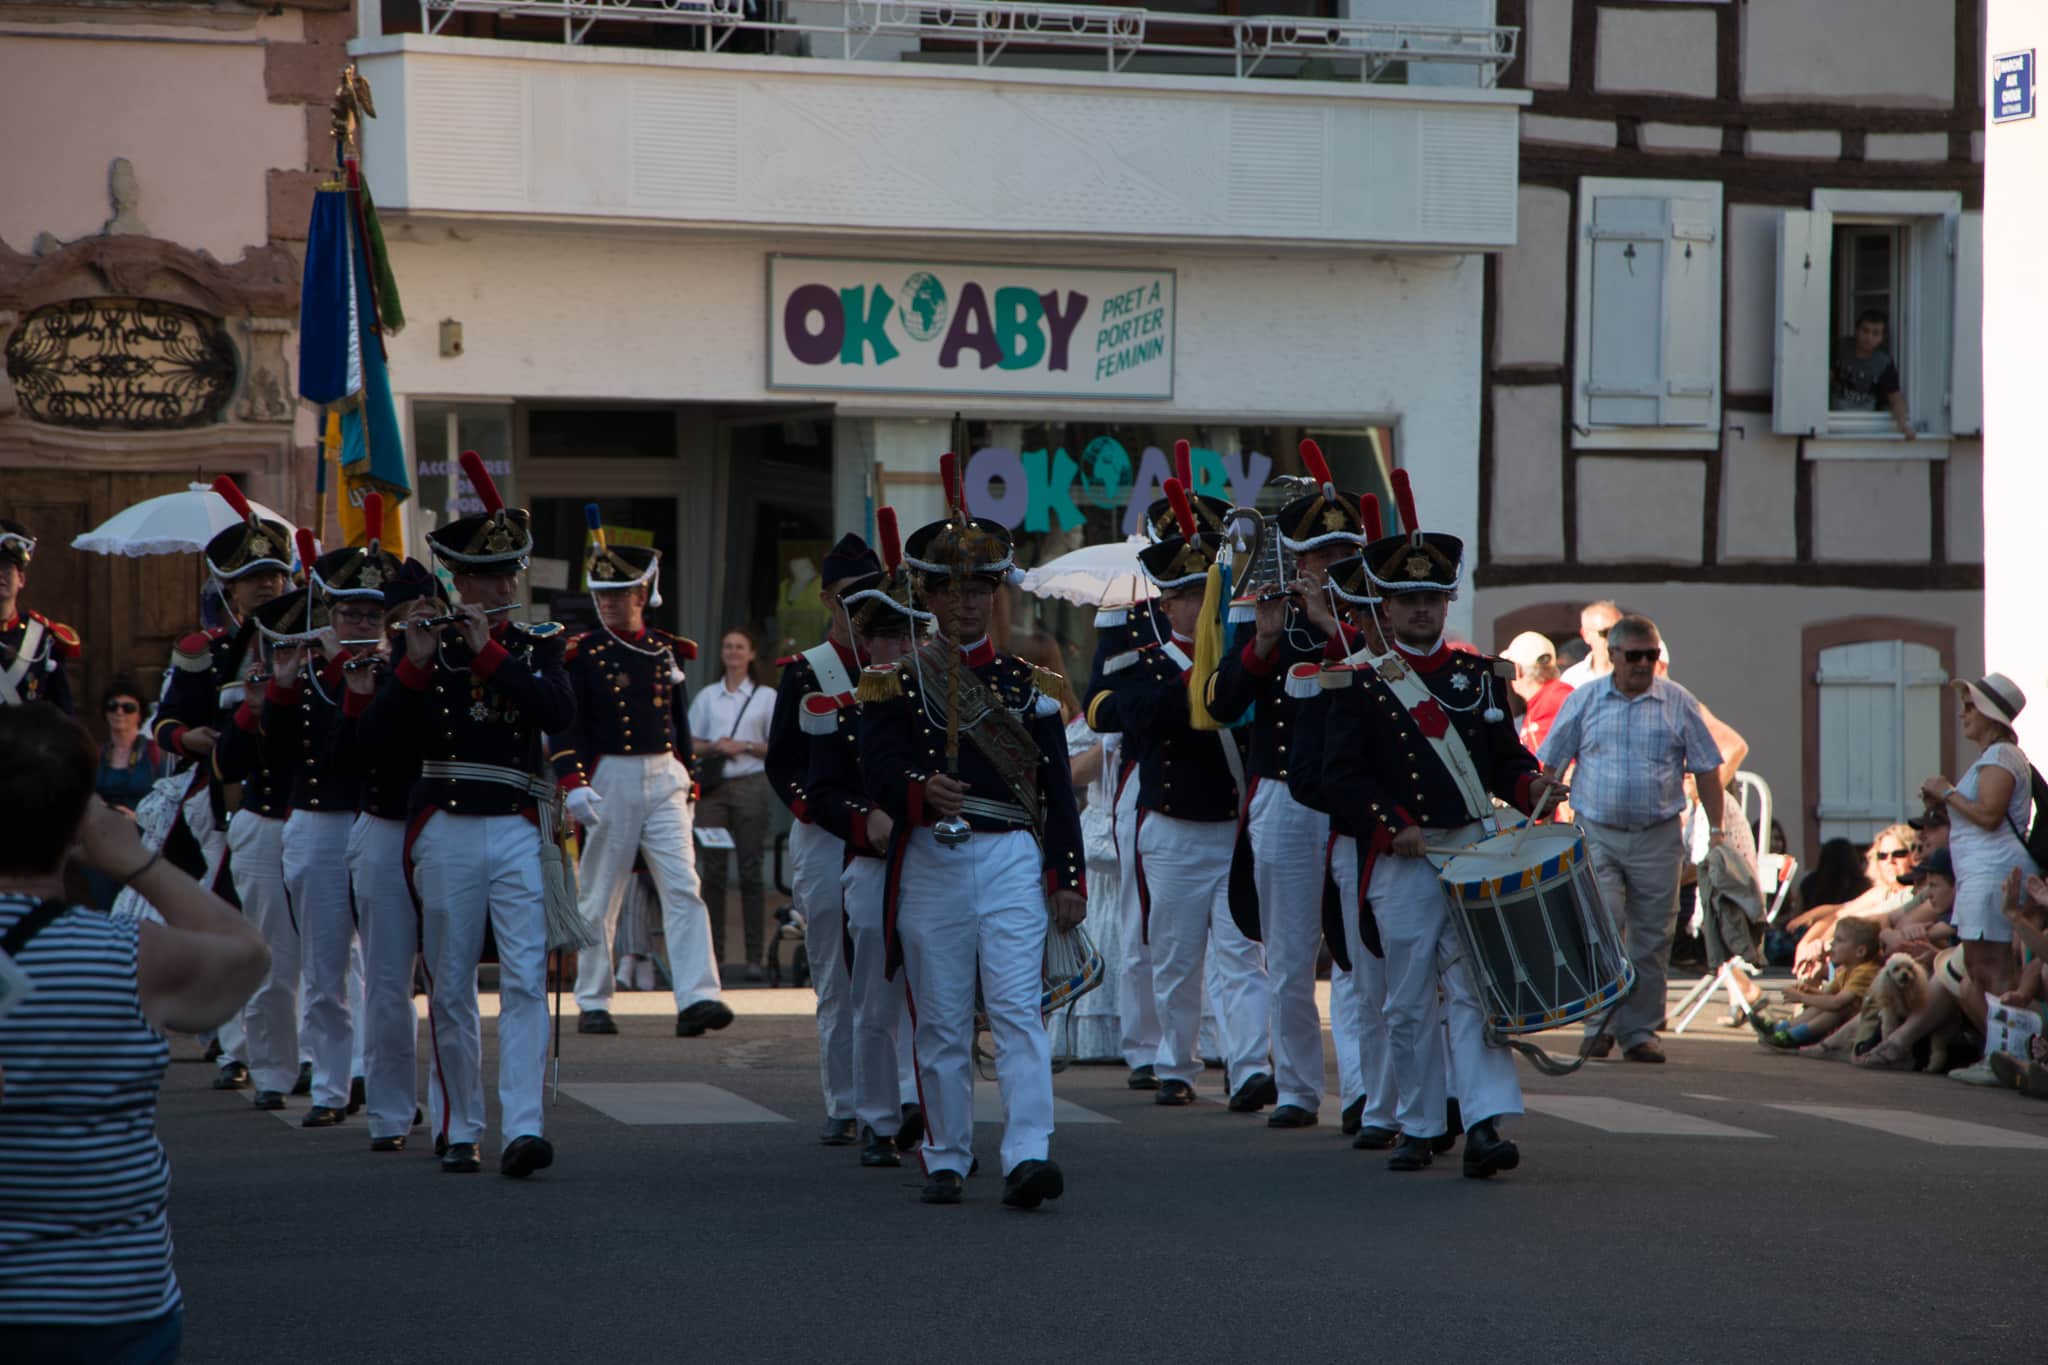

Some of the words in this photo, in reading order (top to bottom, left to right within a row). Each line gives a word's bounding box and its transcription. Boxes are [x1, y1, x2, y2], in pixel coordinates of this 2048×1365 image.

[1102, 285, 1146, 322] PRET
[1148, 280, 1160, 305] A
[784, 283, 899, 366] OK
[938, 282, 1088, 372] ABY
[1096, 307, 1164, 353] PORTER
[1095, 335, 1164, 381] FEMININ
[964, 447, 1088, 534] OK
